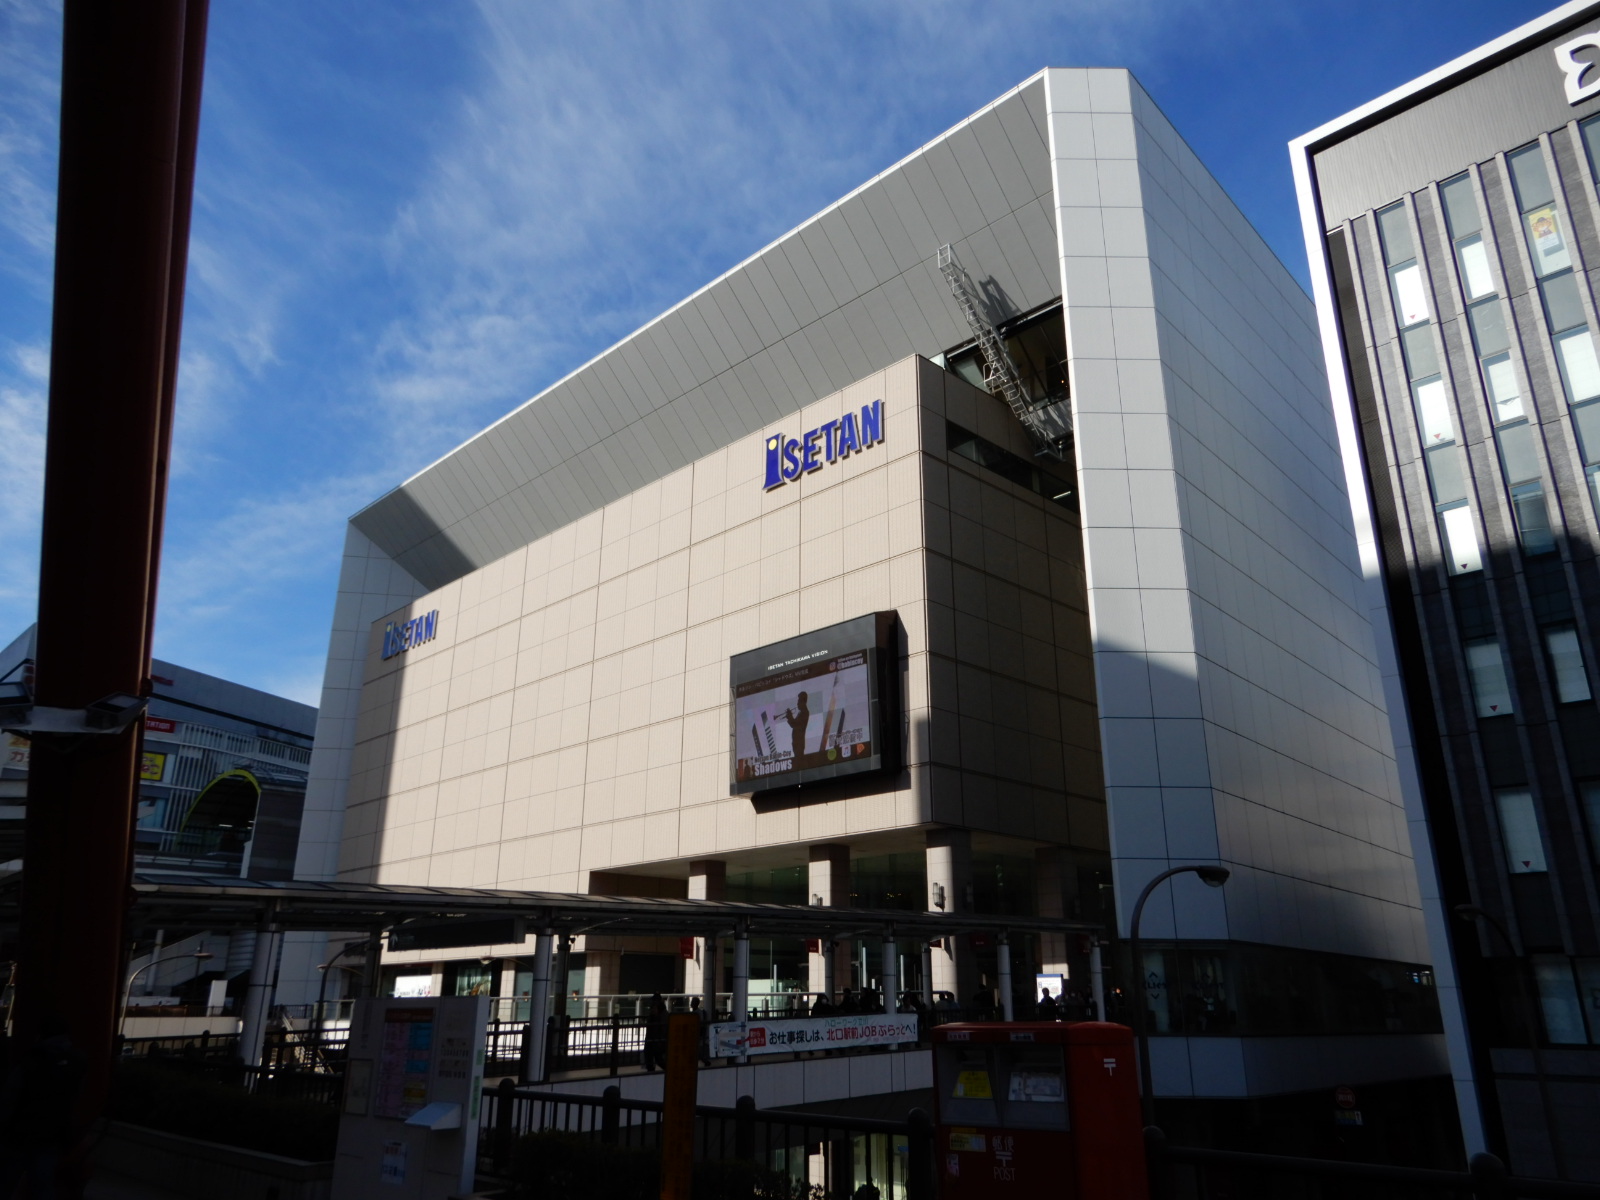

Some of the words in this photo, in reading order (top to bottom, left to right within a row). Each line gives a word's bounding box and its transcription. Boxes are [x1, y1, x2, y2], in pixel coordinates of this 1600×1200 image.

[762, 399, 882, 491] ISETAN
[382, 609, 438, 660] ISETAN
[767, 662, 784, 671] ISETAN
[785, 655, 811, 666] TACHIKAWA
[811, 649, 828, 658] VISION
[754, 759, 793, 776] Shadows
[993, 1166, 1016, 1182] POST
